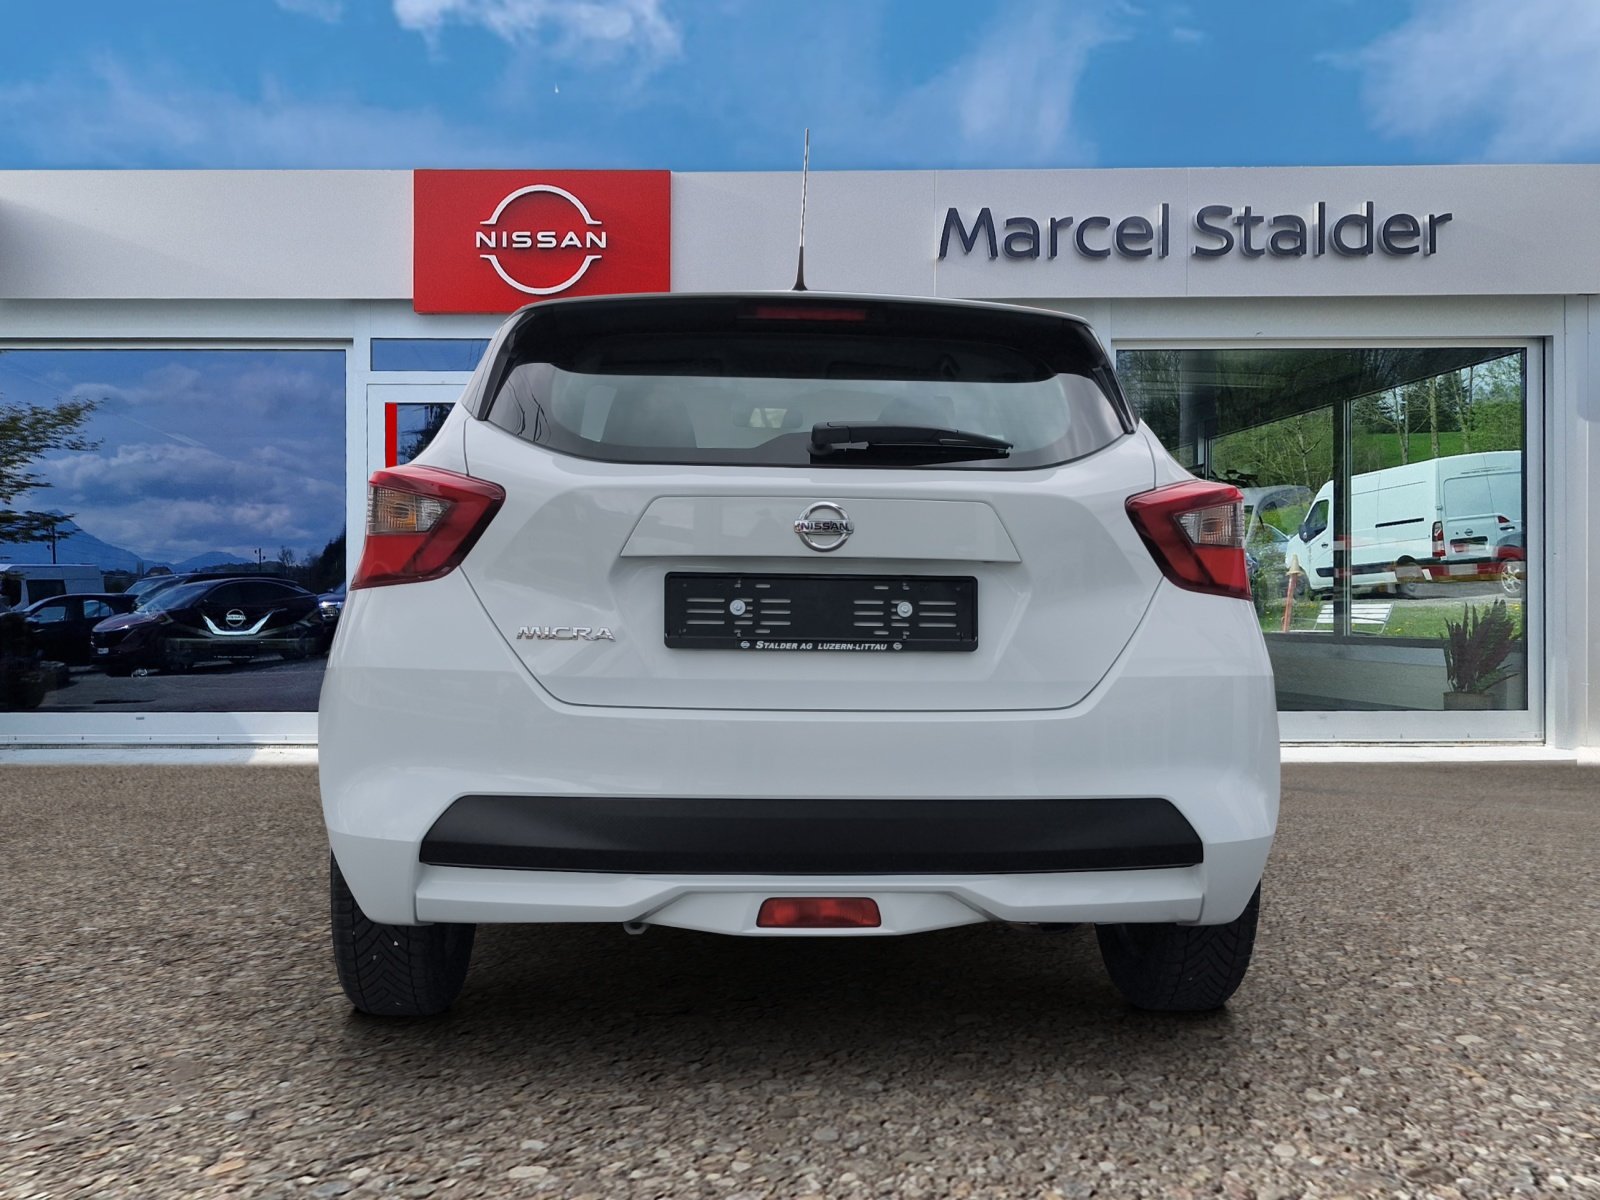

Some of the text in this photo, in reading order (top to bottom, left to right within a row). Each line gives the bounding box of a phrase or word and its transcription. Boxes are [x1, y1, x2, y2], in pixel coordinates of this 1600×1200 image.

[937, 201, 1453, 260] Marcel Stalder
[475, 231, 607, 248] NISSAN
[800, 522, 849, 531] NISSAN
[516, 626, 617, 642] MICRA
[800, 642, 813, 650] AG
[817, 642, 888, 651] LUZERN-LITTAU
